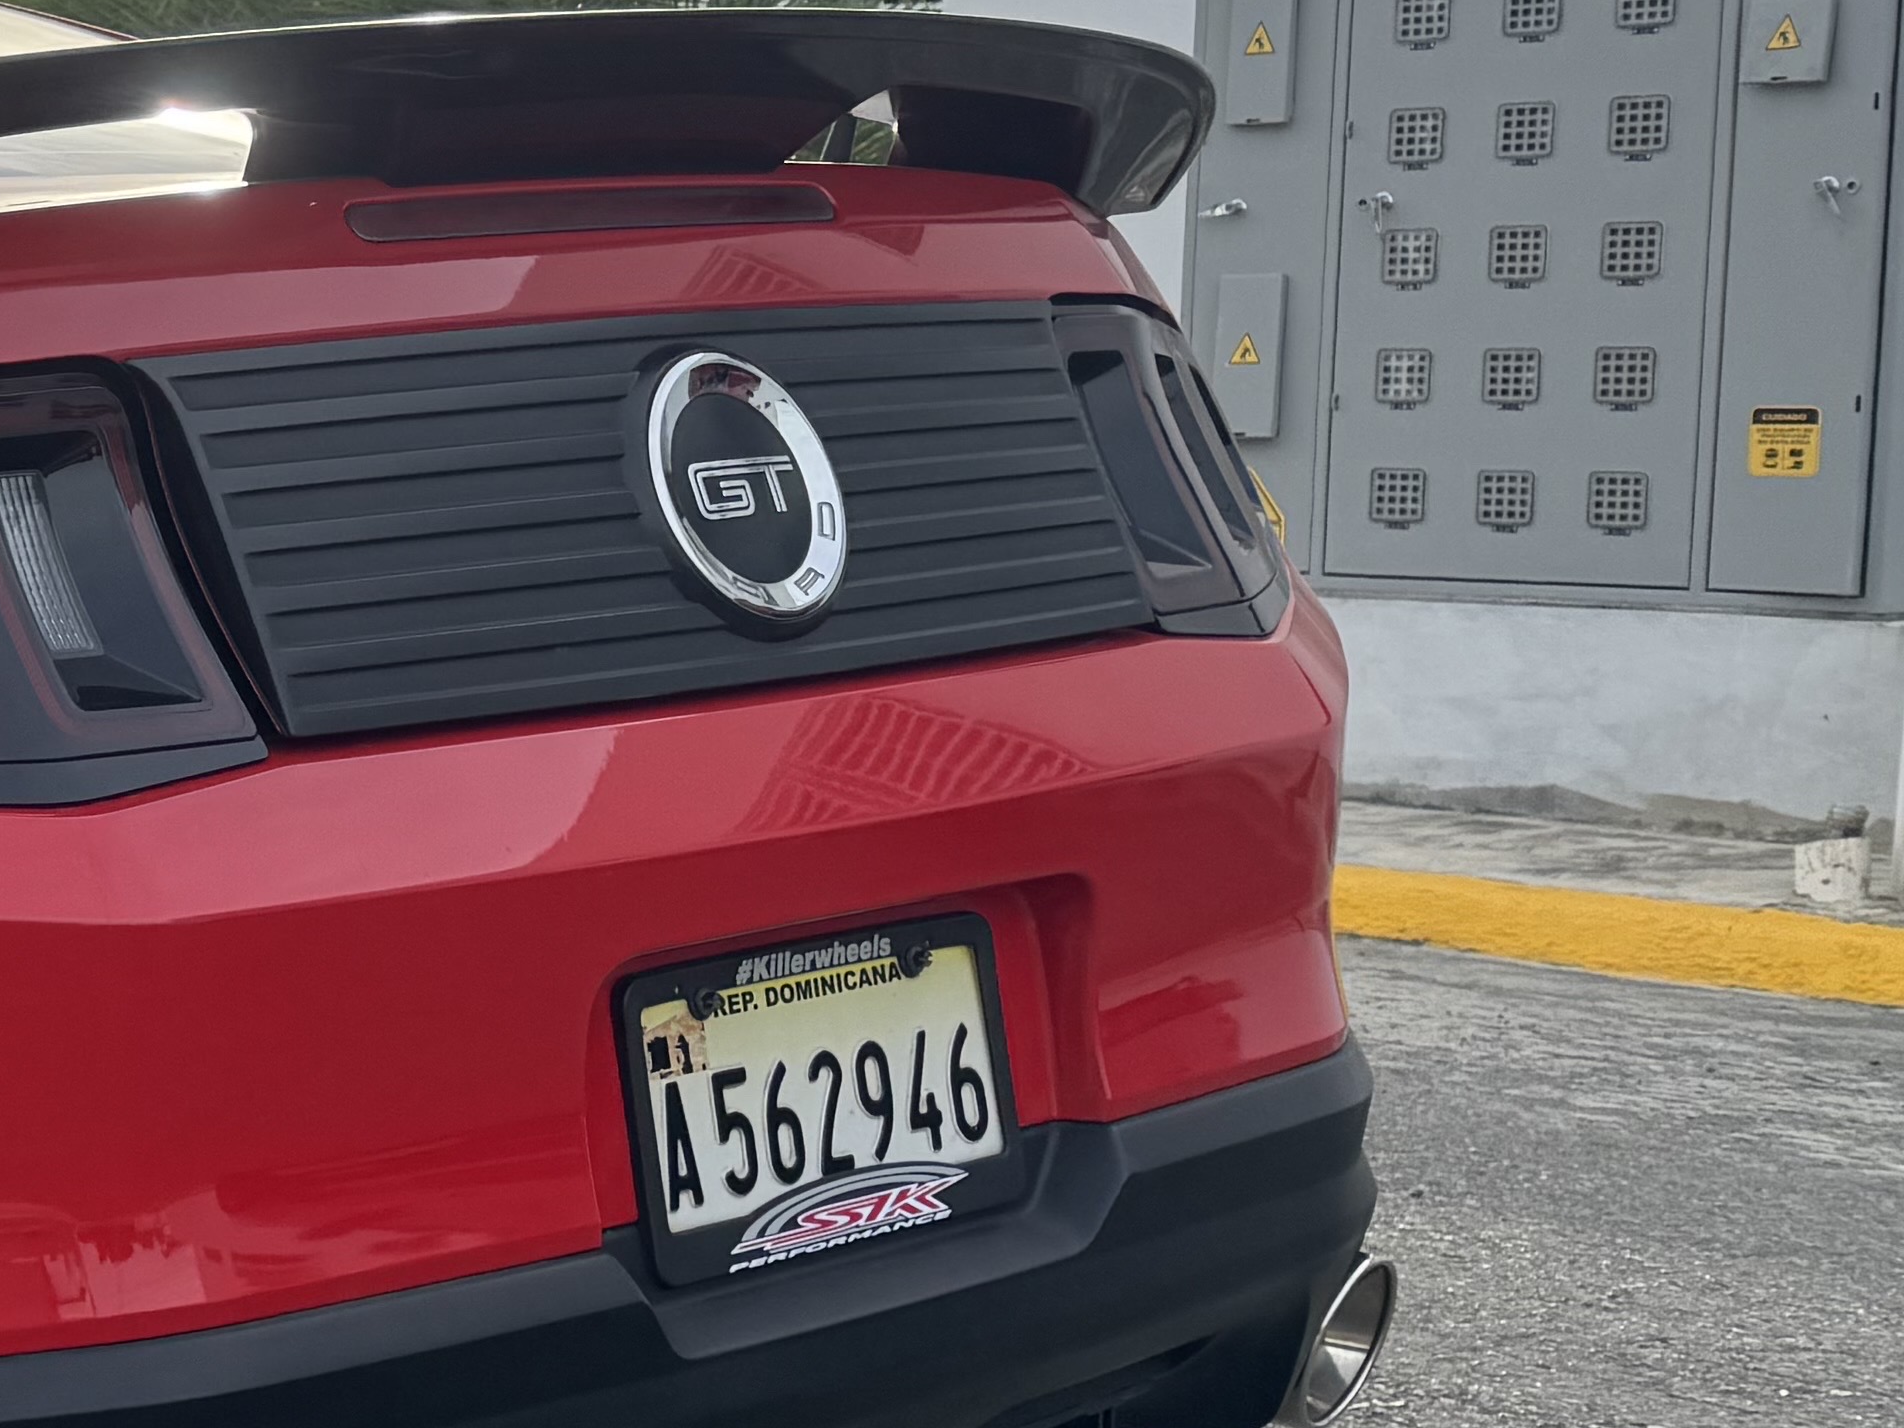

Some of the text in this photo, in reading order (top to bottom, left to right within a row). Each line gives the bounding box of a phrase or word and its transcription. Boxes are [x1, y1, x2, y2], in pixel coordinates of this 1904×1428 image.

[687, 454, 794, 521] GT
[713, 960, 902, 1018] REP. DOMINICANA
[735, 933, 892, 986] #Killerwheels
[664, 1022, 989, 1213] A562946
[729, 1209, 953, 1274] PERFORMANCE
